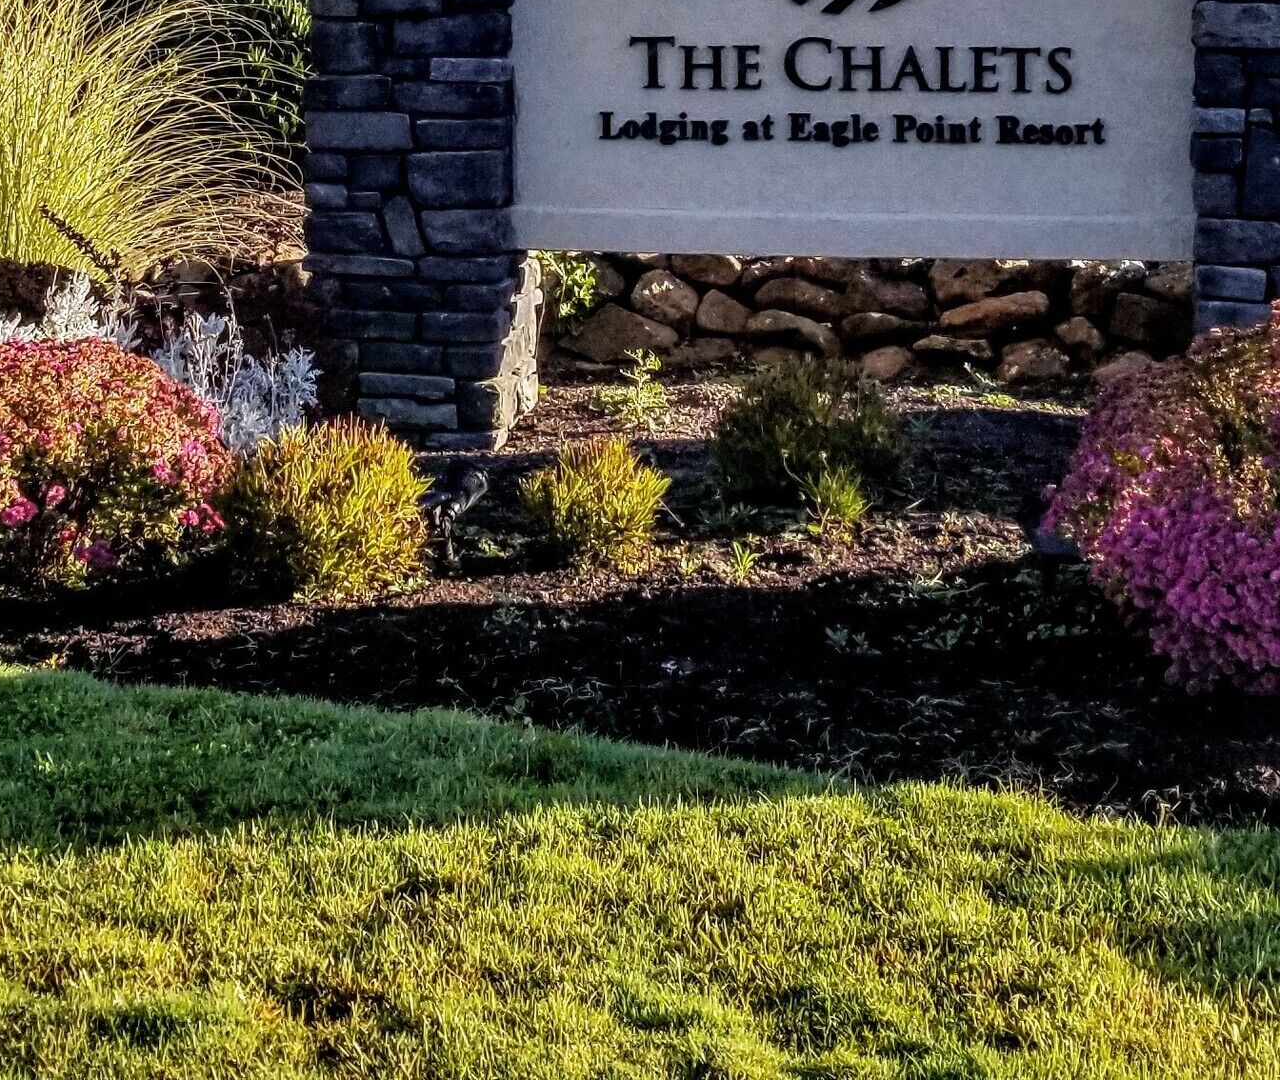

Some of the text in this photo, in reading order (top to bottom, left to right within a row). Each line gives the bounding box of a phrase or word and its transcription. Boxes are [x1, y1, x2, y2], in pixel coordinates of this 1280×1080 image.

[627, 35, 1074, 95] THE CHALETS
[597, 111, 1109, 149] Lodging at Eagle Point Resort
